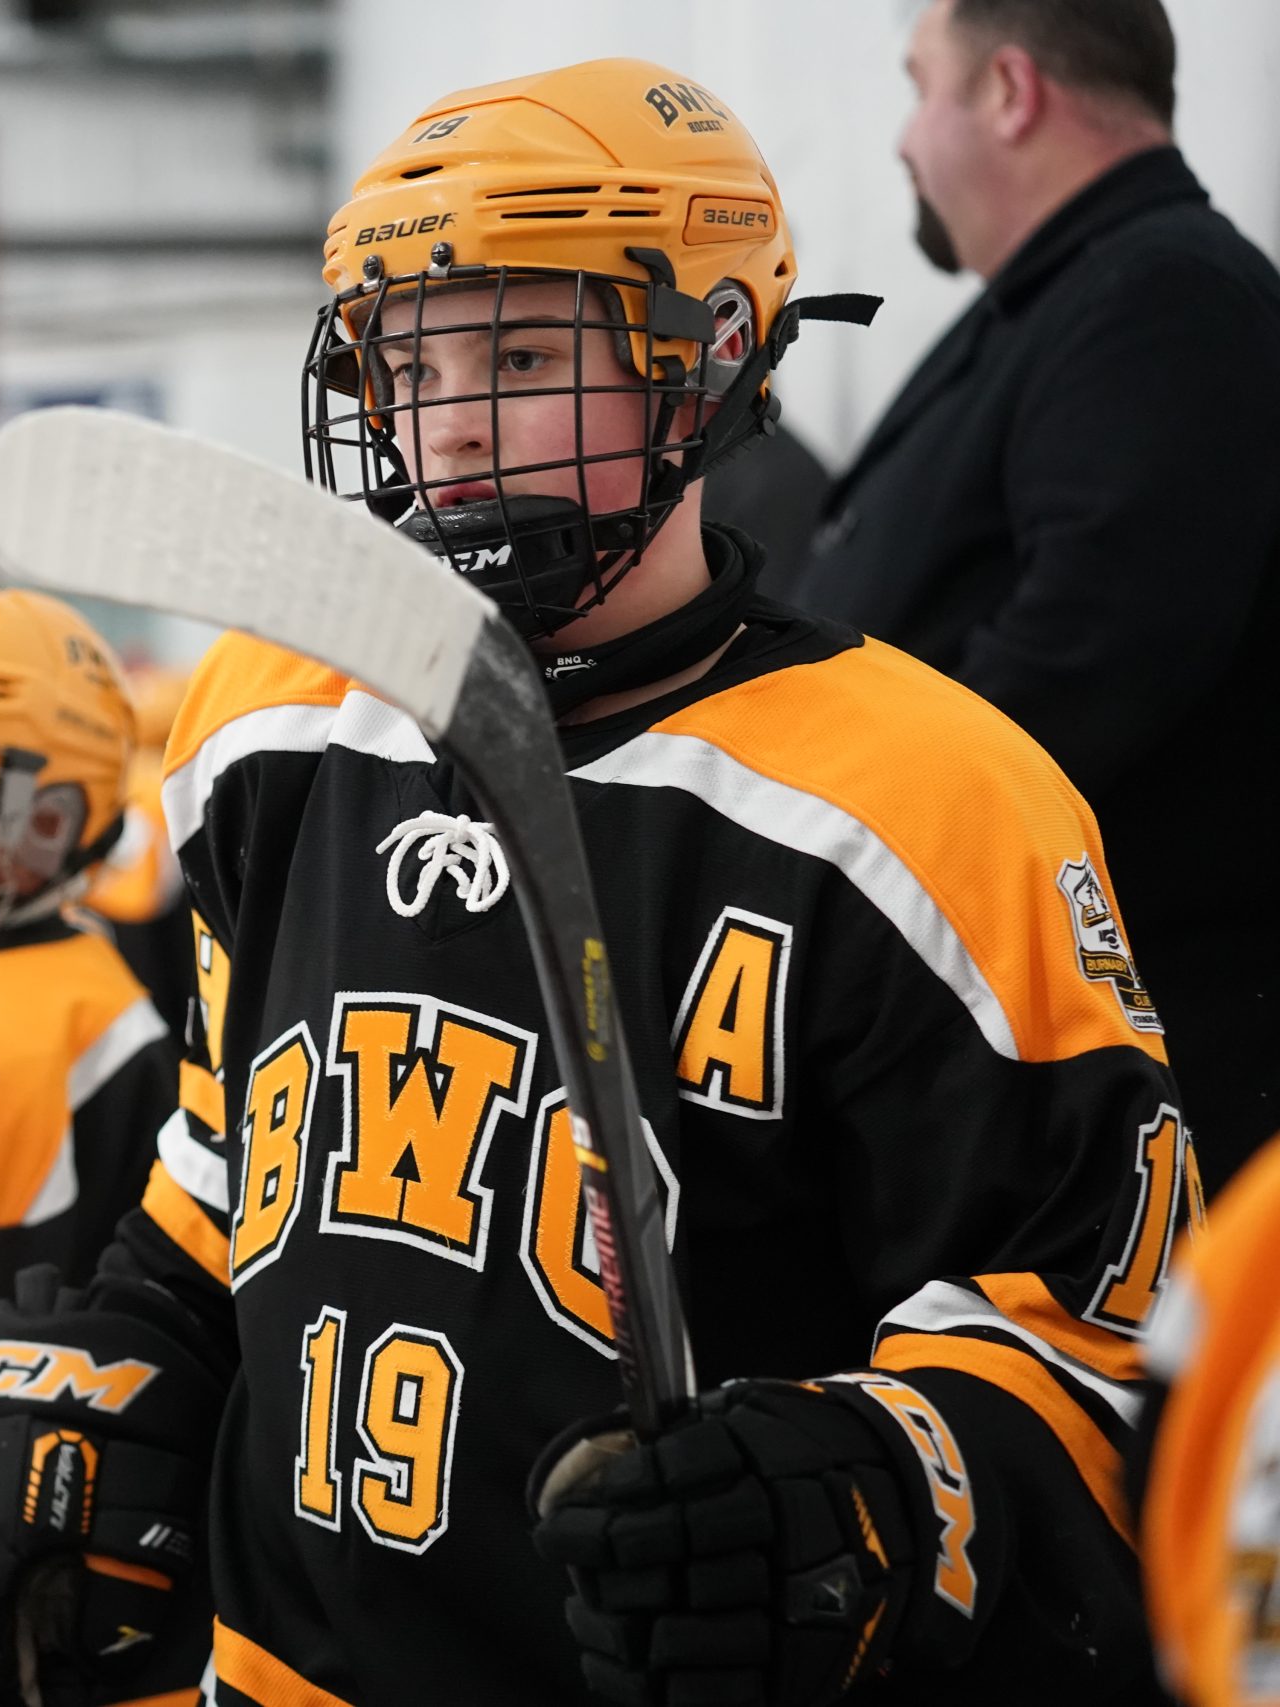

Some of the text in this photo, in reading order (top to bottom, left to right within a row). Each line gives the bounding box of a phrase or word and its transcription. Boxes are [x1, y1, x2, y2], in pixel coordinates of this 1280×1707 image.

[409, 114, 471, 145] 19
[557, 655, 581, 666] BNQ
[673, 905, 793, 1120] A
[295, 1305, 465, 1555] 19
